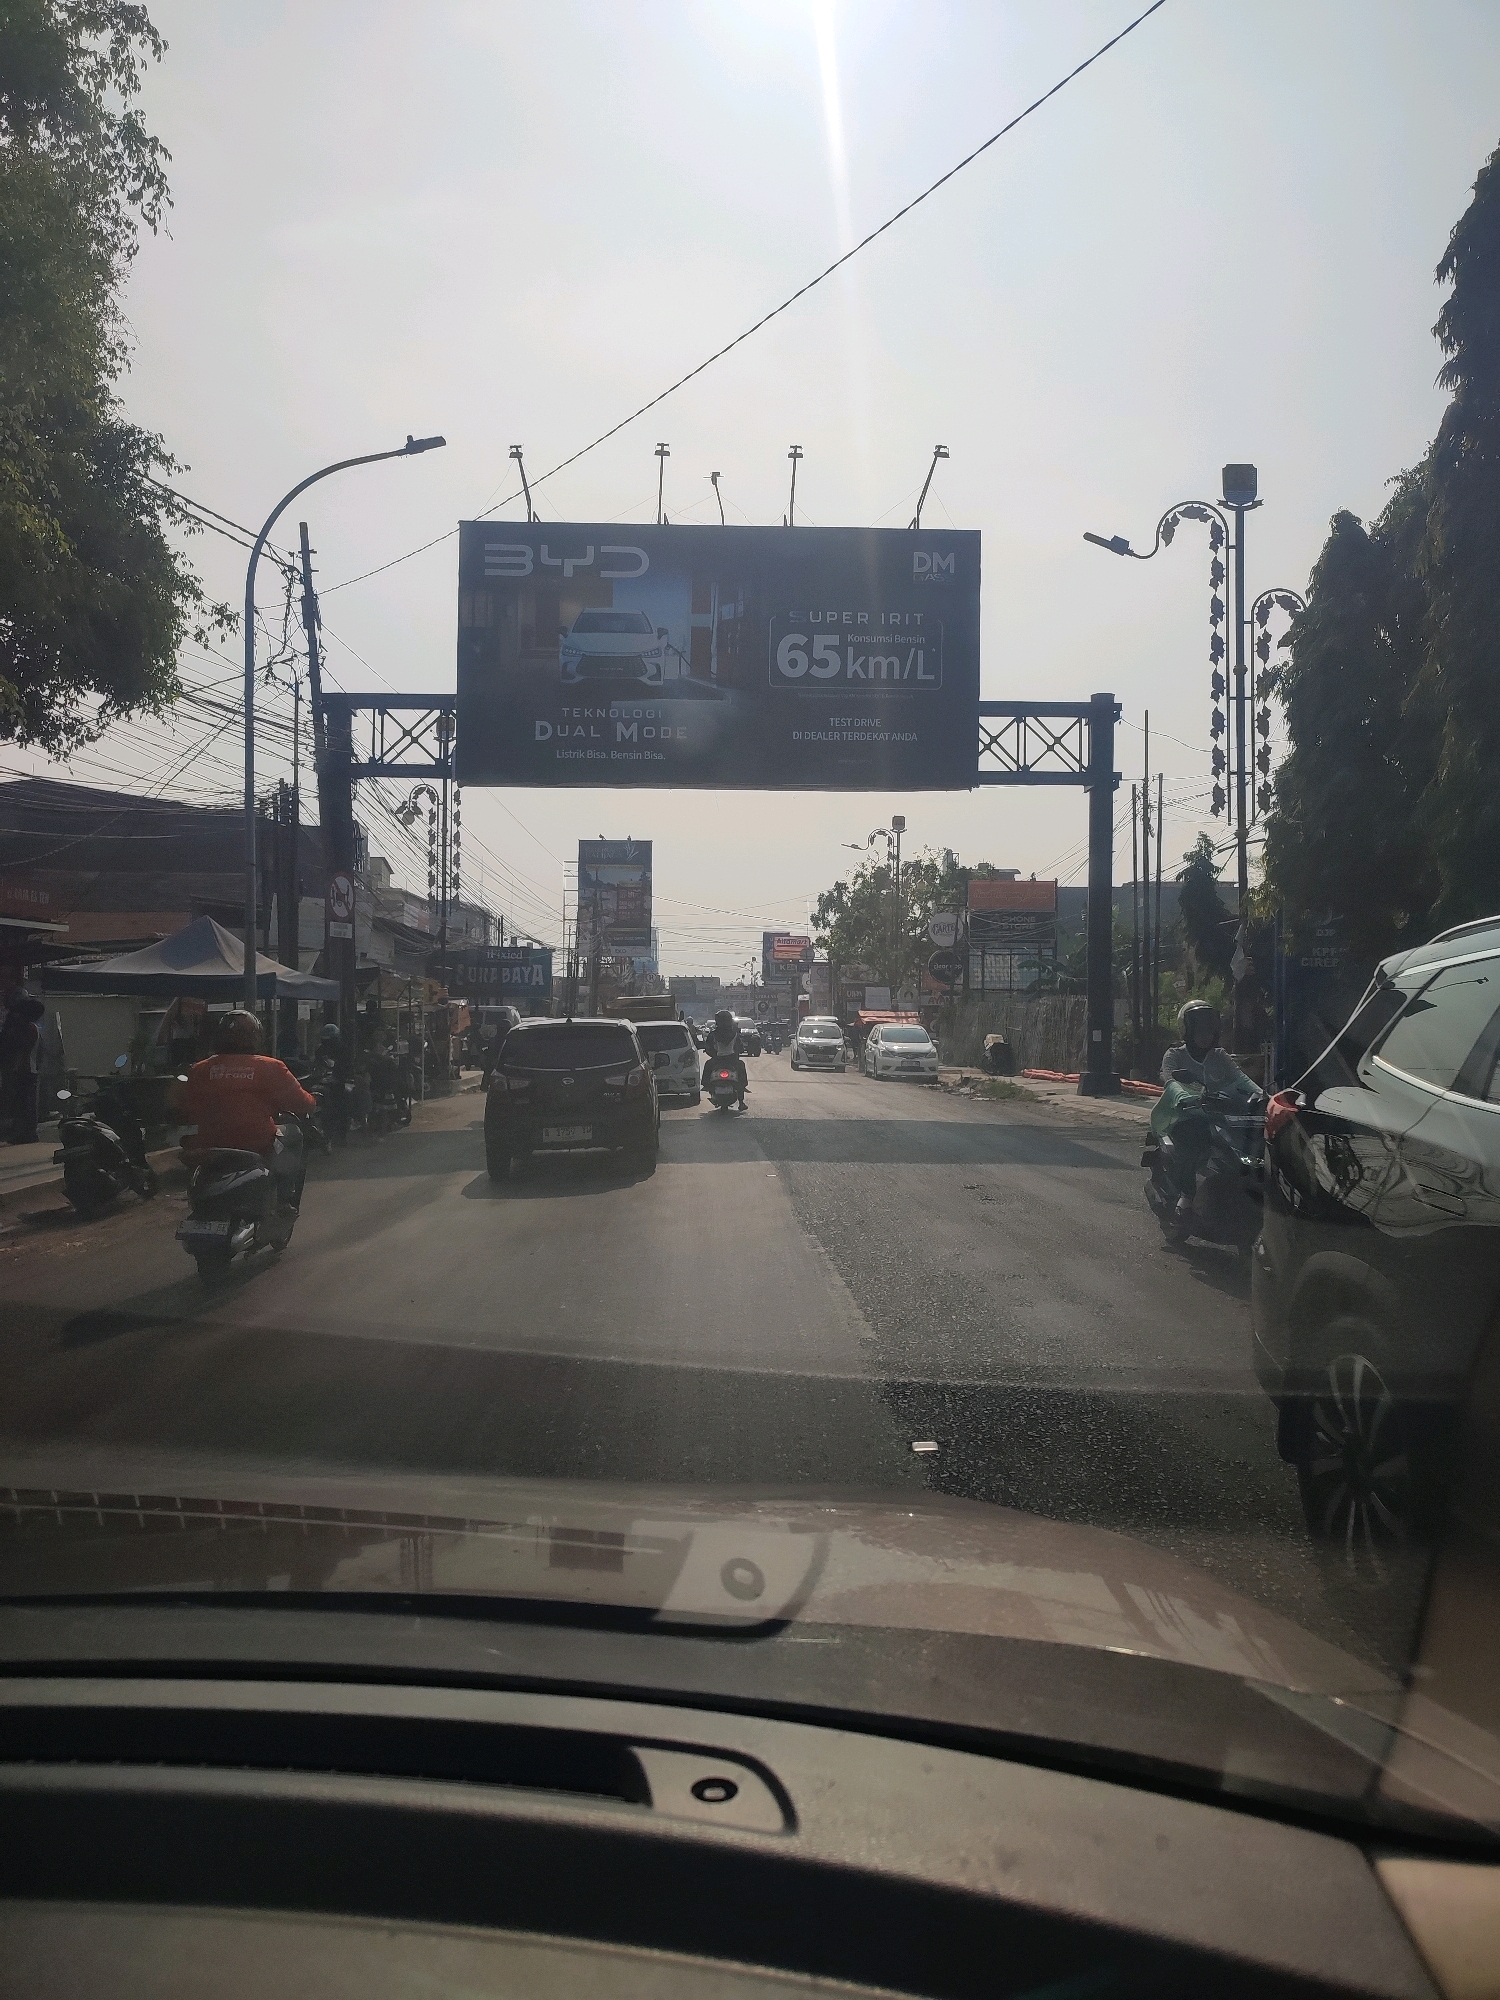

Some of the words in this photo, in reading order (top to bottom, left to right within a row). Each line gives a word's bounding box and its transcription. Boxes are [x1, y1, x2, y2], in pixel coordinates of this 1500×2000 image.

[484, 543, 650, 578] BYD
[913, 551, 955, 574] DM
[789, 610, 869, 625] SUPER
[881, 612, 924, 626] IRIT
[847, 633, 893, 643] Konsumsi
[894, 634, 926, 644] Bensin
[776, 633, 842, 679] 65
[561, 707, 662, 719] TEKNOLOGI
[829, 717, 853, 727] TEST
[854, 718, 882, 728] DRIVE
[792, 731, 803, 740] DI
[804, 731, 841, 741] DEALER
[841, 731, 891, 741] TERDEKAT
[891, 732, 918, 742] ANDA
[556, 749, 585, 759] Listrik
[586, 750, 609, 760] Bisa.
[610, 750, 642, 760] Bensin
[644, 750, 666, 760] Bisa.
[457, 964, 545, 986] SURABAYA
